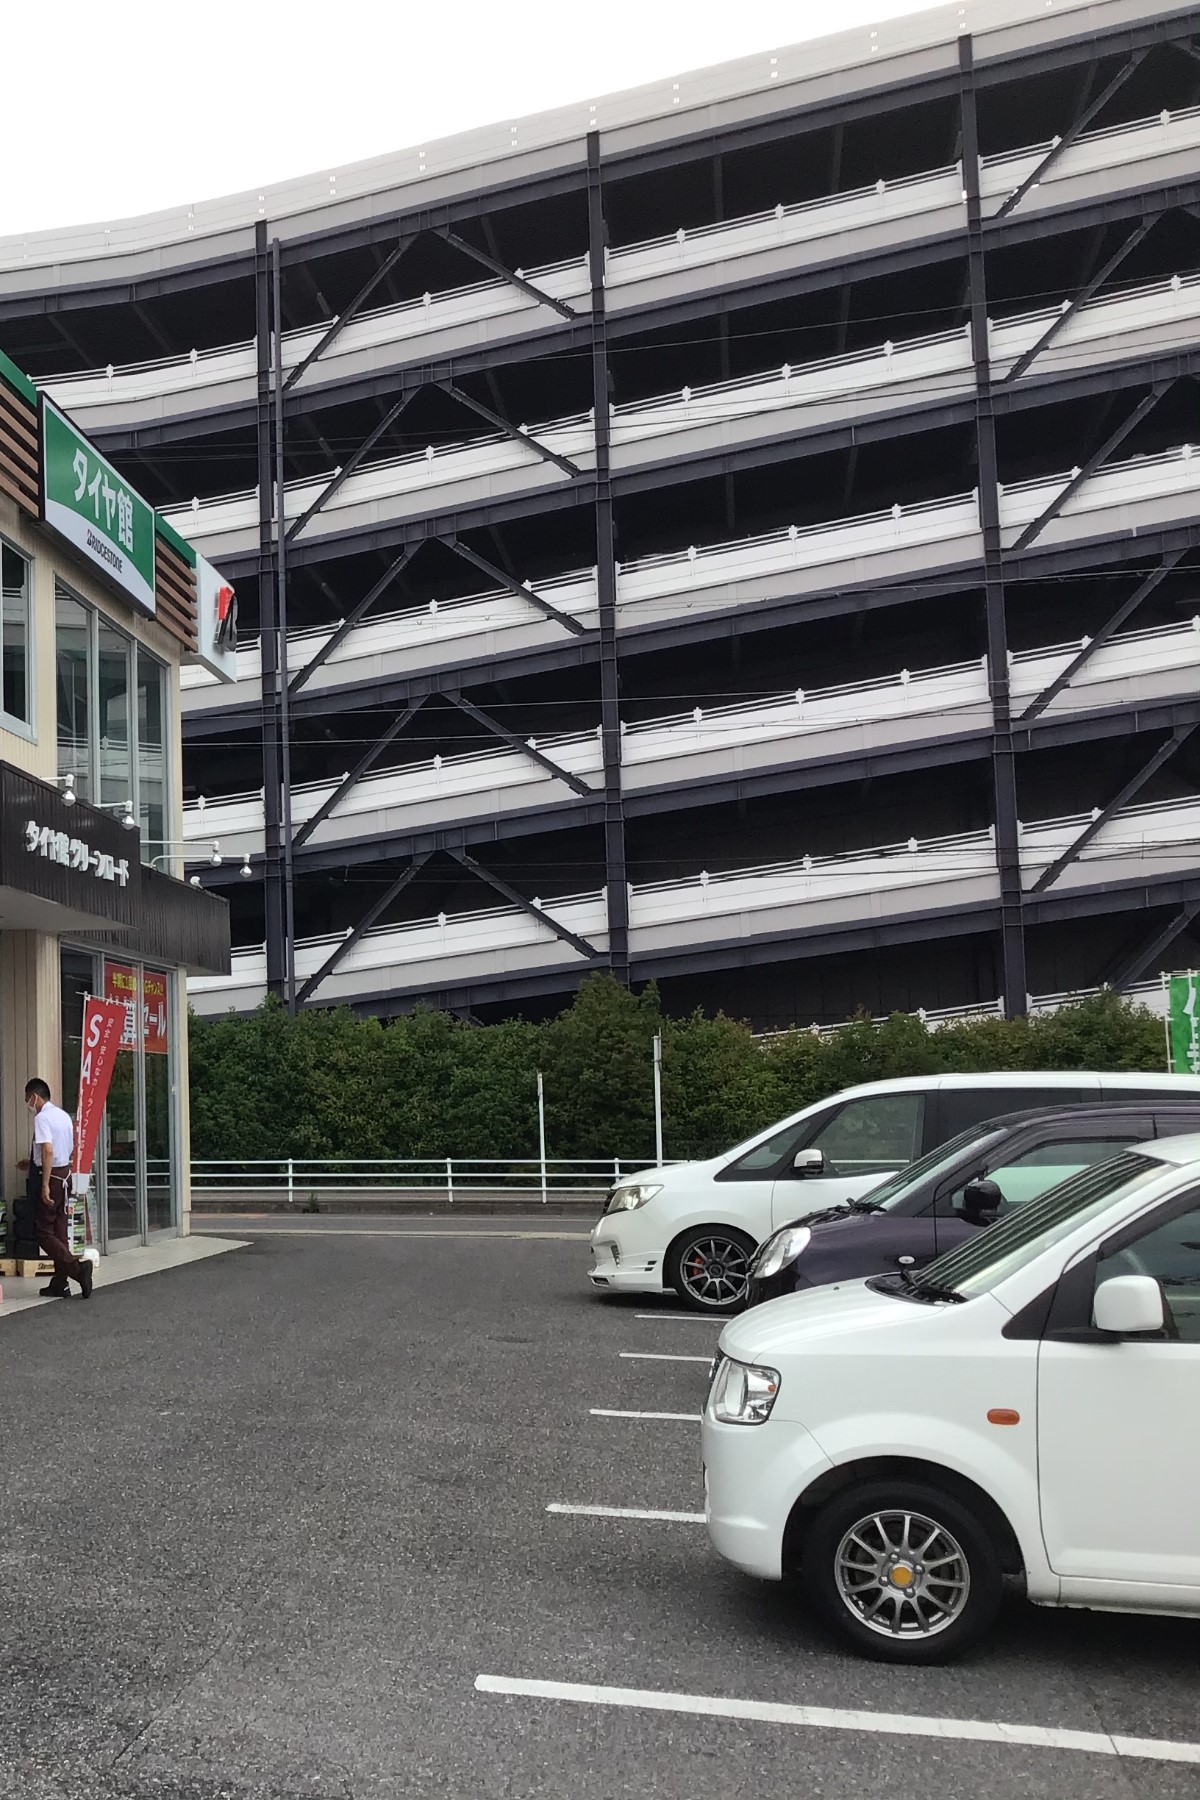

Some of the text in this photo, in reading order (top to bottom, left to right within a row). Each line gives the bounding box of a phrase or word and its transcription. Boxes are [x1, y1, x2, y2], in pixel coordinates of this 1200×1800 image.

[72, 448, 134, 553] タイヤ館
[86, 528, 123, 574] BRIDGESTONE
